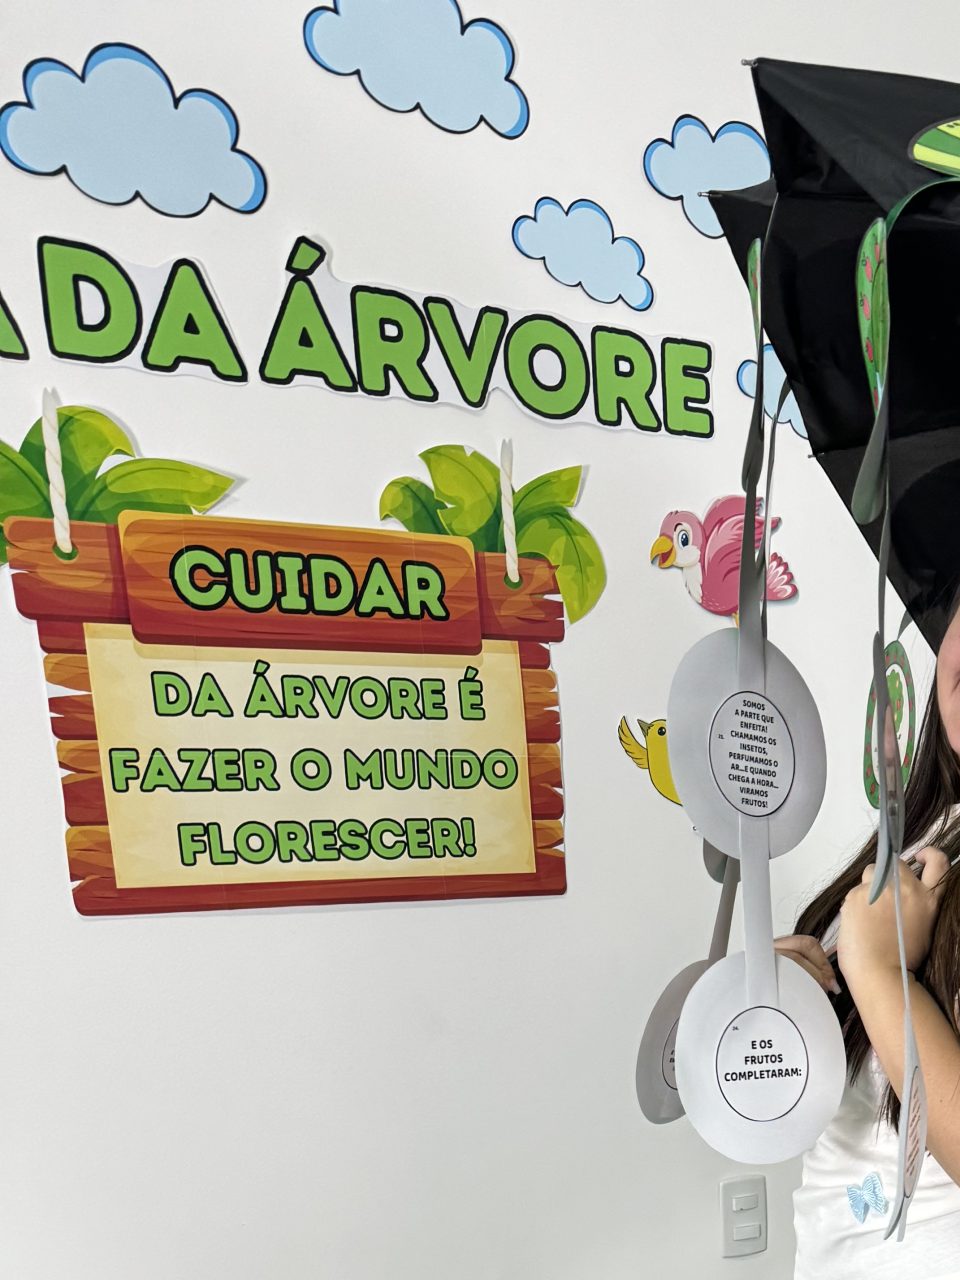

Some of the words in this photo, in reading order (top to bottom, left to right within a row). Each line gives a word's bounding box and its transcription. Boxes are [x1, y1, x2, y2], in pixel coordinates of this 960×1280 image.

[37, 235, 248, 383] DA
[258, 235, 715, 439] ÁRVORE
[169, 545, 450, 621] CUIDAR
[150, 671, 234, 720] DA
[243, 660, 449, 720] ÁRVORE
[459, 665, 486, 721] É
[742, 700, 765, 710] SOMOS
[740, 710, 760, 720] PARTE
[761, 715, 774, 723] QUE
[740, 721, 767, 733] ENFEITA!
[730, 730, 767, 743] CHAMAMOS
[768, 737, 776, 746] OS
[740, 743, 767, 755] INSETOS,
[729, 752, 772, 766] PERFUMAMOS
[109, 748, 281, 793] FAZER
[291, 748, 332, 791] O
[345, 747, 519, 792] MUNDO
[750, 766, 776, 777] QUANDO
[728, 773, 750, 784] CHEGA
[740, 786, 768, 797] VIRAMOS
[741, 798, 768, 808] FRUTOS!
[178, 817, 478, 867] FLORESCER!
[751, 1040, 757, 1049] E
[759, 1039, 772, 1049] OS
[744, 1054, 783, 1065] FRUTOS
[724, 1068, 802, 1081] COMPLETARAM:
